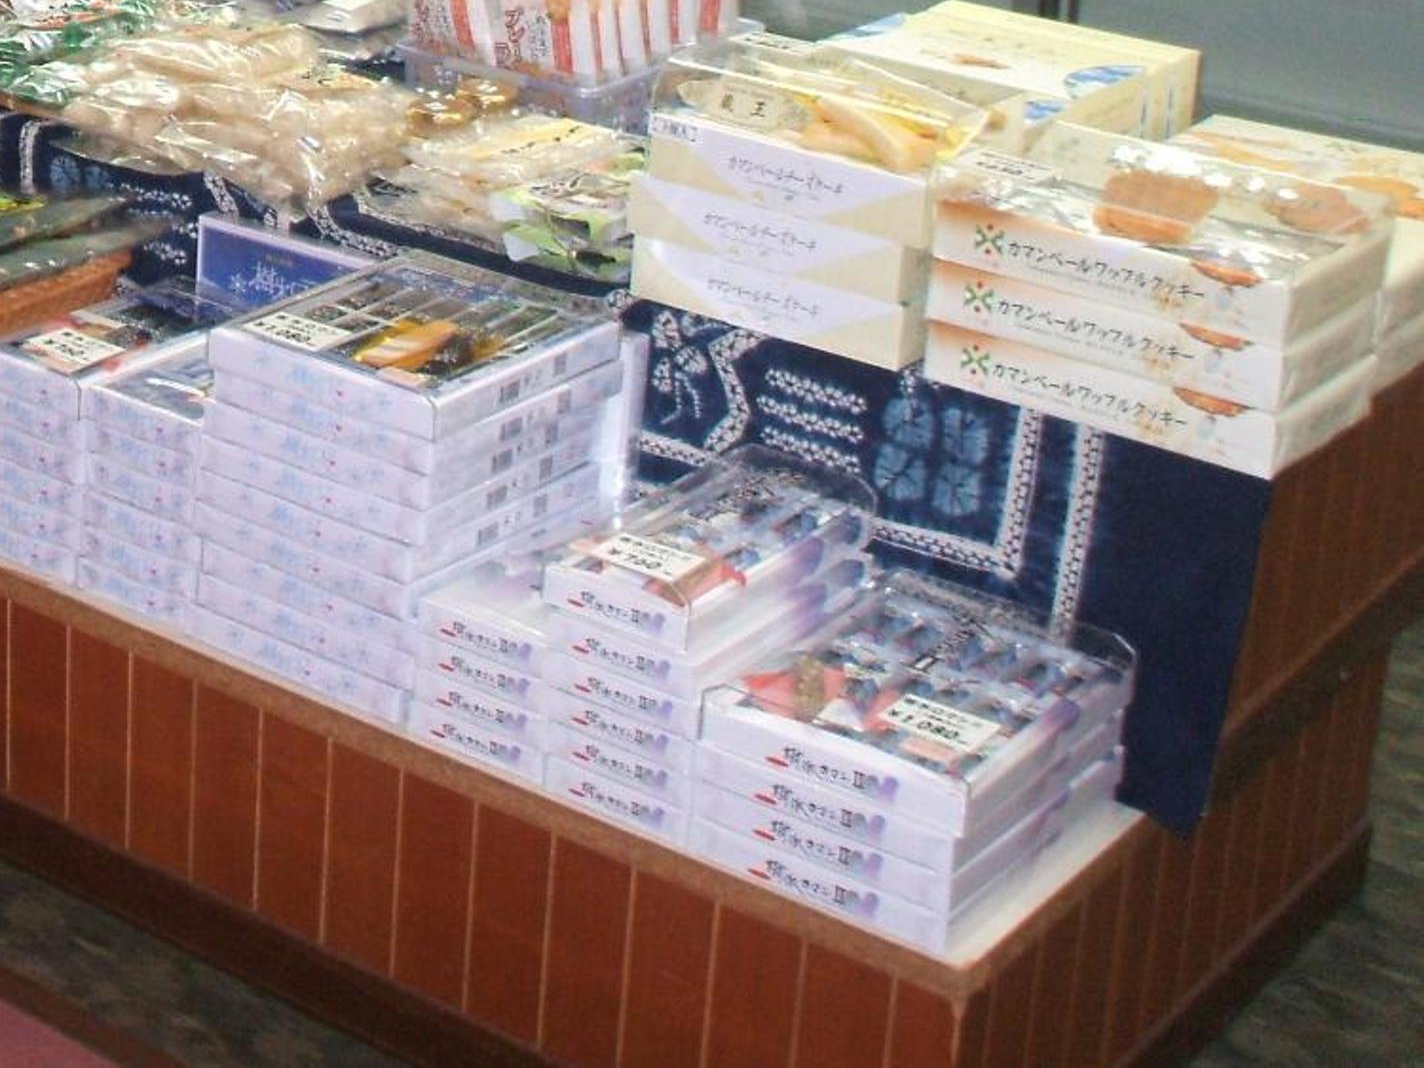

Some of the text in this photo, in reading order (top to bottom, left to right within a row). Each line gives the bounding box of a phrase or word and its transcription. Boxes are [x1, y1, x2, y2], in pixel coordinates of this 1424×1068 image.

[1008, 241, 1206, 299] カマンベールワッフルクッキー
[996, 298, 1196, 360] カマンベールワッフルクッキー
[991, 362, 1188, 427] カマンベールワッフルクッキー
